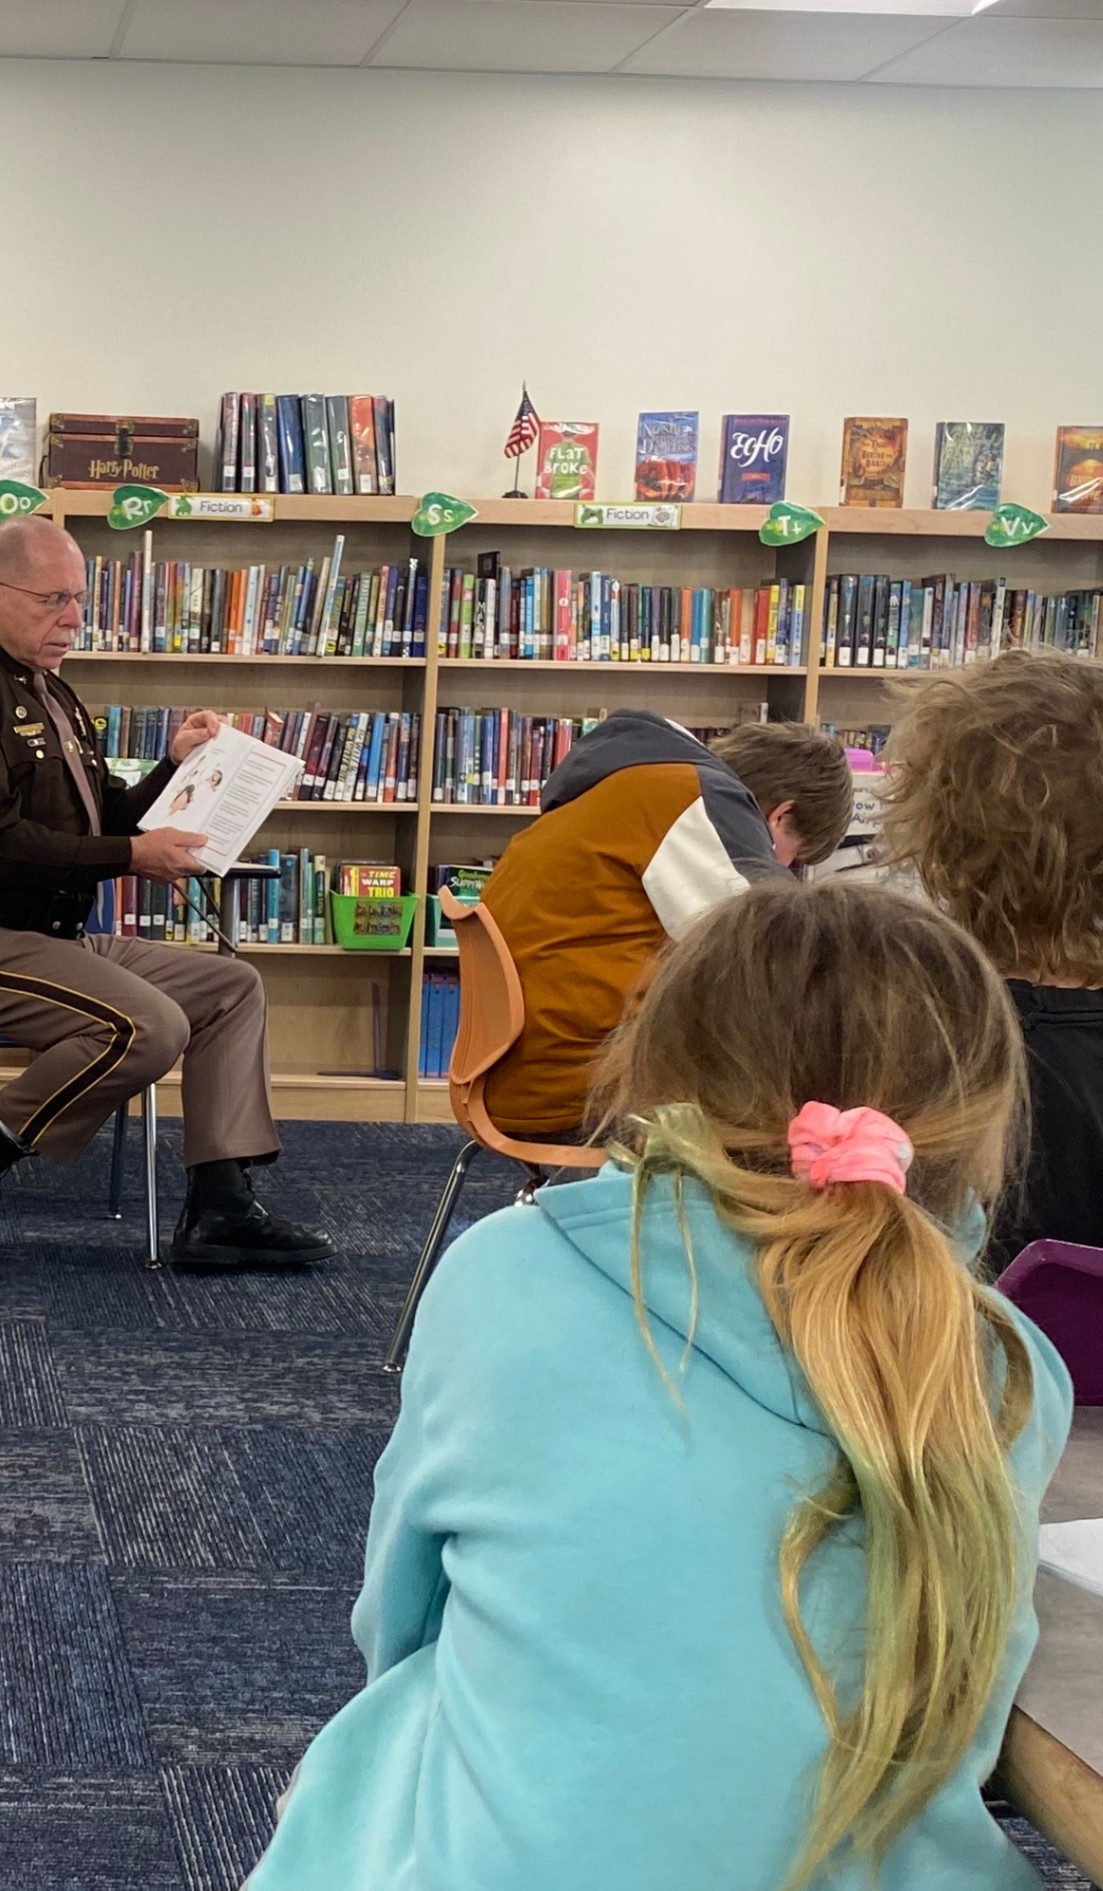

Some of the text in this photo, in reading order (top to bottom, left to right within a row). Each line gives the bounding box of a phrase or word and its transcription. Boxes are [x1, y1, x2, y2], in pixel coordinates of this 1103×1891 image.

[88, 459, 160, 480] Harry Potter
[0, 492, 32, 515] Oo
[120, 496, 153, 521] Rr
[199, 501, 244, 514] Fiction
[427, 503, 455, 527] Ss
[605, 507, 650, 522] Fiction
[777, 515, 804, 537] Tt
[1001, 516, 1035, 537] Vv
[362, 878, 394, 886] WARP
[368, 870, 396, 878] TIME
[367, 886, 395, 898] TRIO
